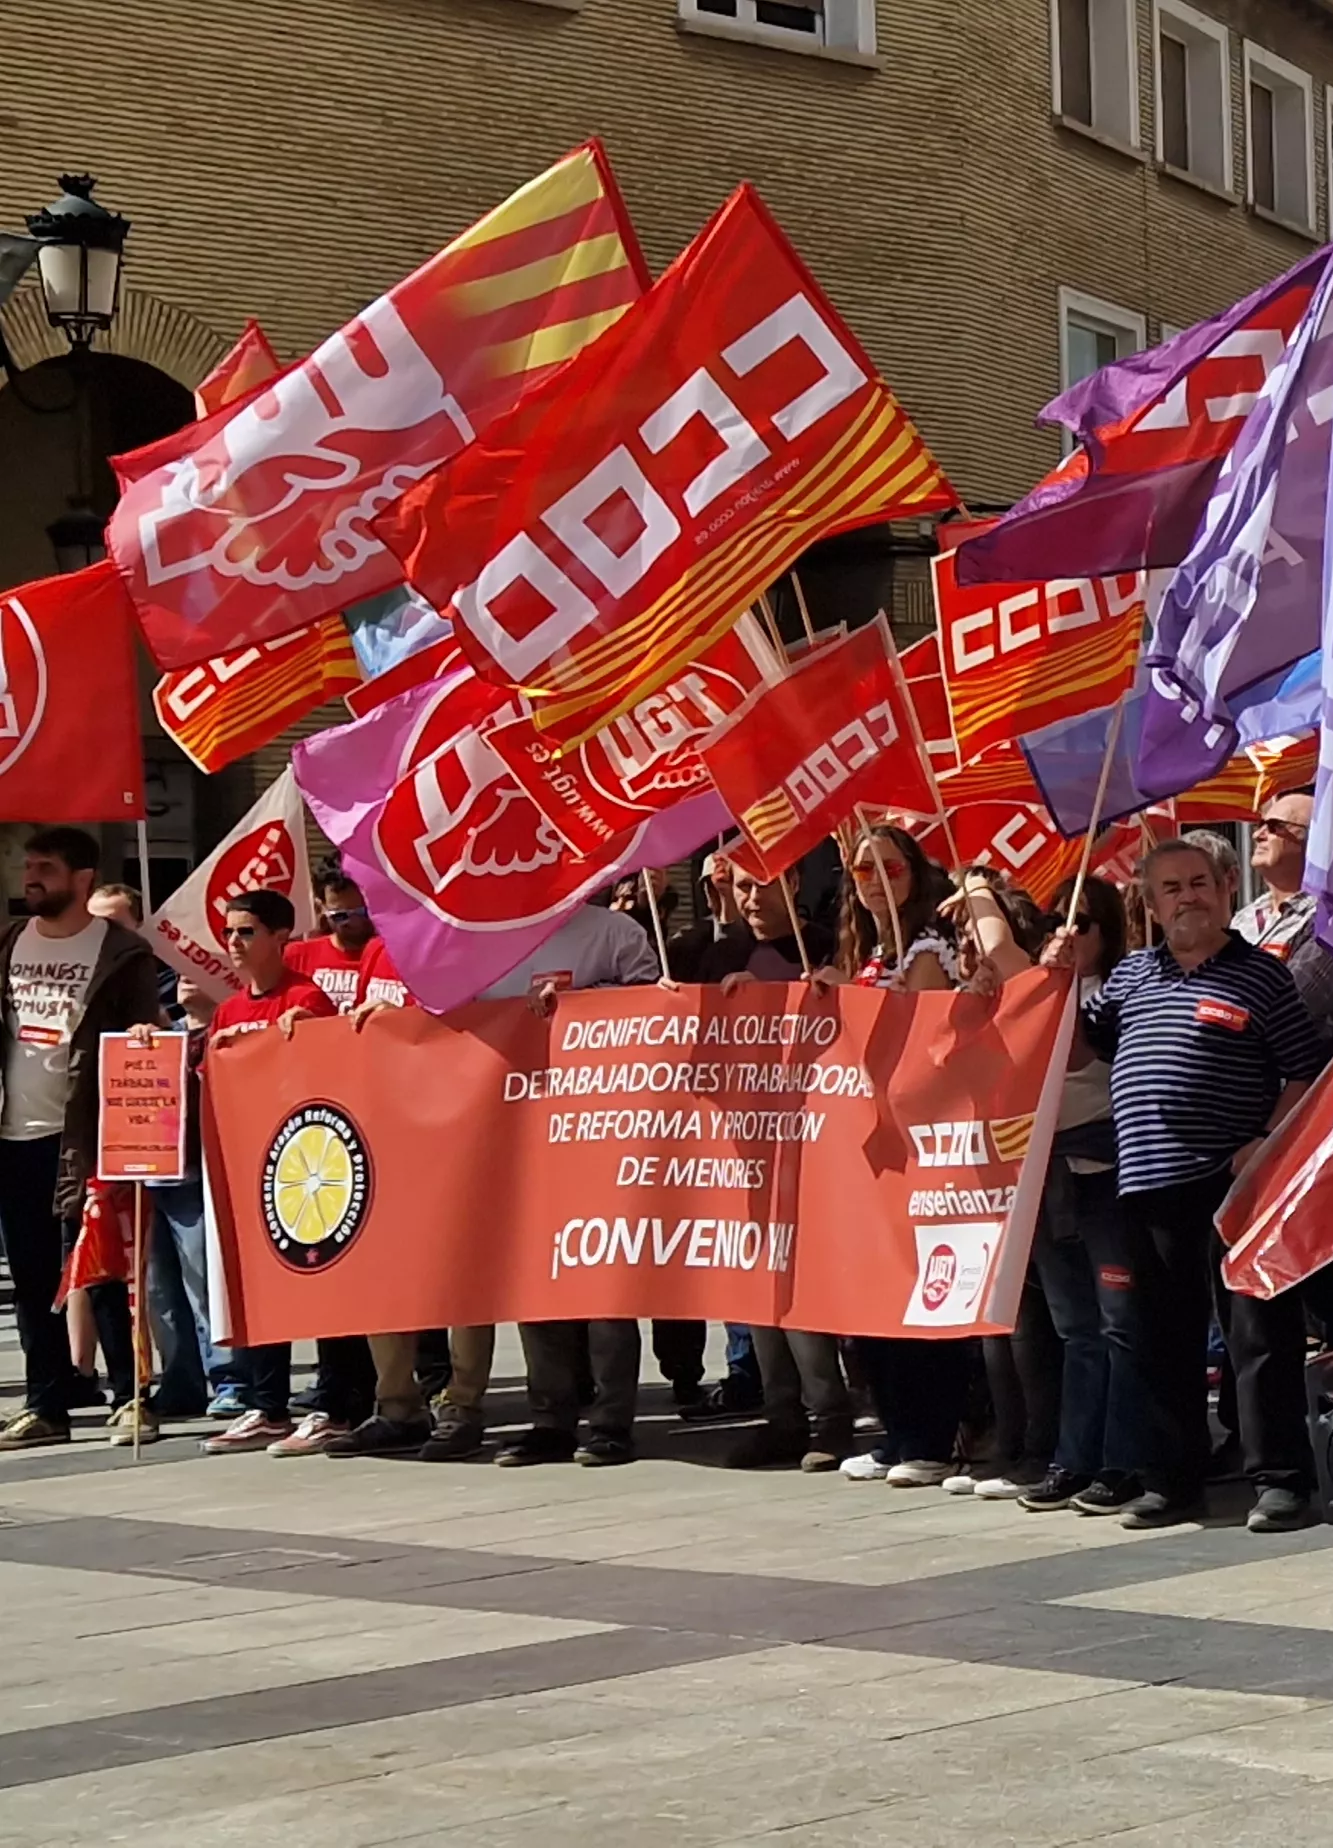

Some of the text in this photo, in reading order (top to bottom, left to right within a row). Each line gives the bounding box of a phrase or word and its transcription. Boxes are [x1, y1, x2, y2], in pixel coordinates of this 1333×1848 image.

[596, 672, 733, 779] UGT
[562, 1014, 837, 1050] DIGNIFICAR AL COLECTIVO
[503, 1071, 542, 1101] DE
[545, 1062, 718, 1097] TRABAJADORES
[724, 1063, 736, 1090] Y
[549, 1113, 575, 1143] DE
[576, 1109, 701, 1140] REFORMA
[709, 1112, 724, 1139] Y
[908, 1120, 990, 1167] CCOO
[616, 1156, 766, 1189] DE MENORES
[908, 1182, 1017, 1216] enseñanza
[551, 1217, 761, 1280] ¡CONVENIO
